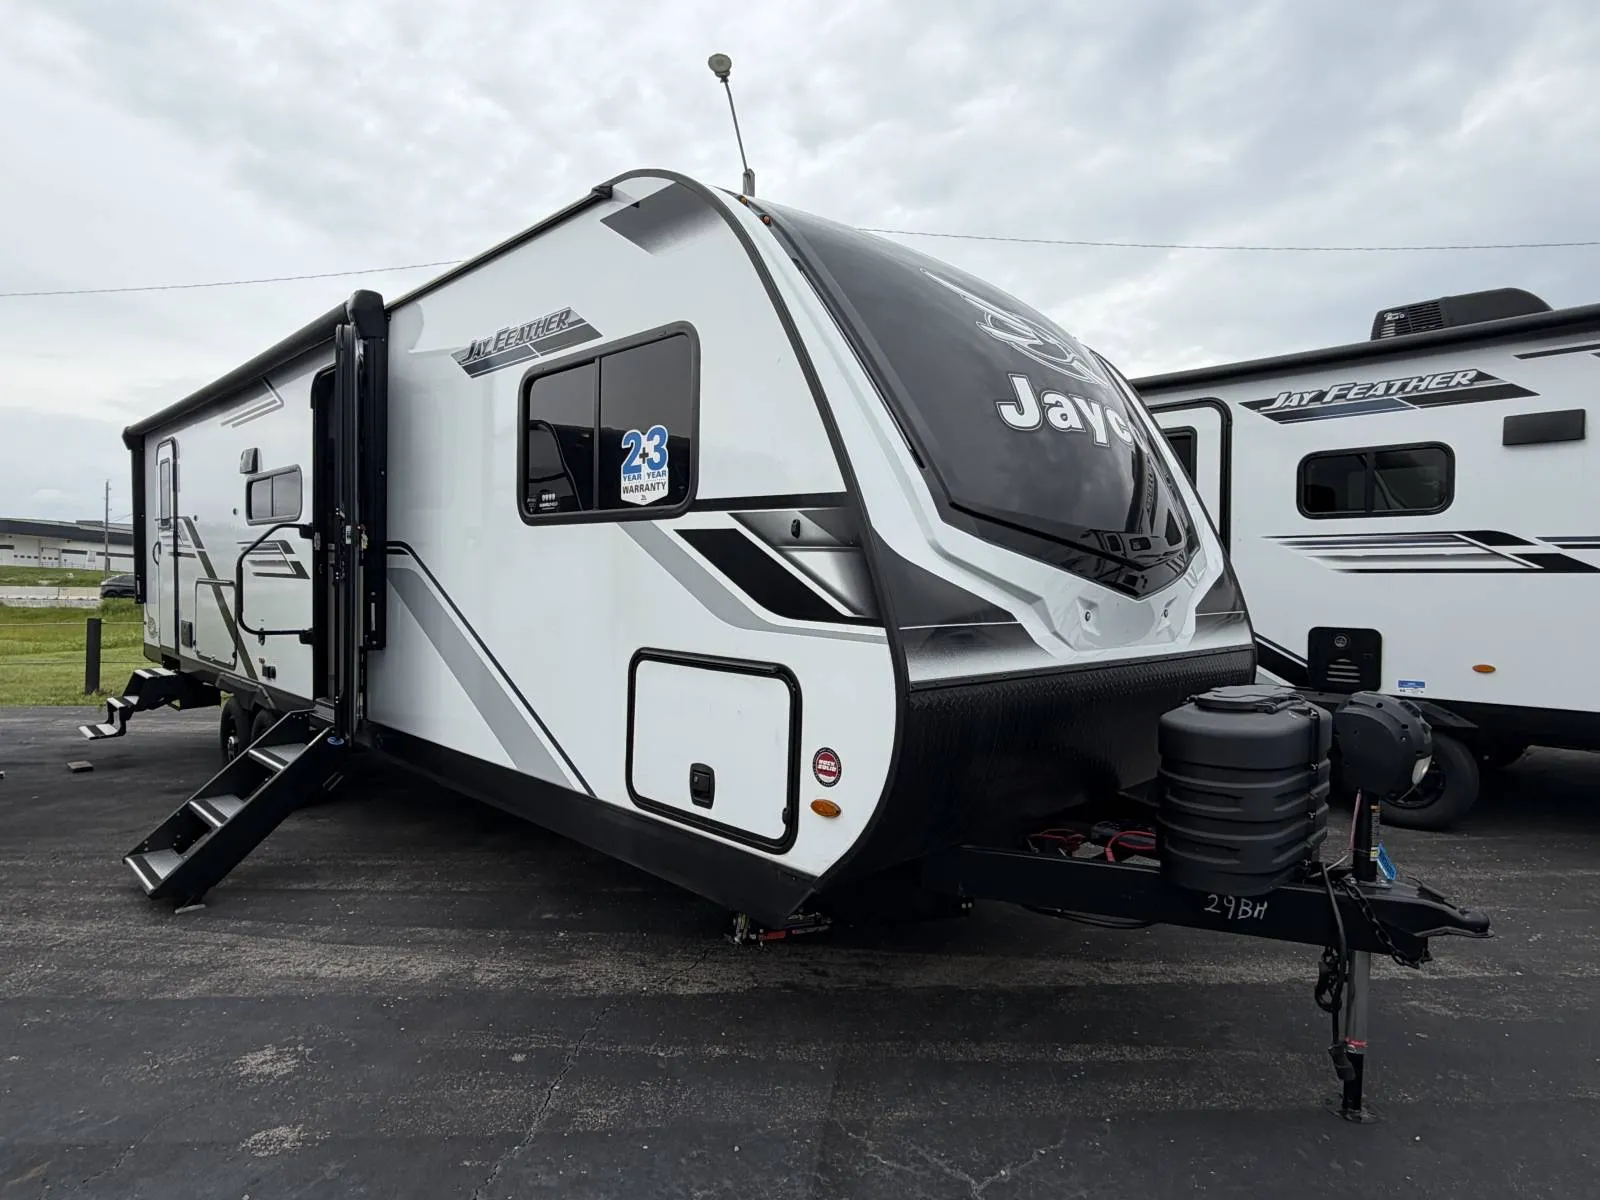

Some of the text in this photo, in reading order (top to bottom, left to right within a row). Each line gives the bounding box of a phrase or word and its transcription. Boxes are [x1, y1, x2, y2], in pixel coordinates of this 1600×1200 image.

[461, 309, 571, 363] JAY FEATHER
[1259, 369, 1478, 411] JAY FEATHER
[623, 470, 667, 482] YEAR YEAR
[623, 482, 666, 494] WARRANTY
